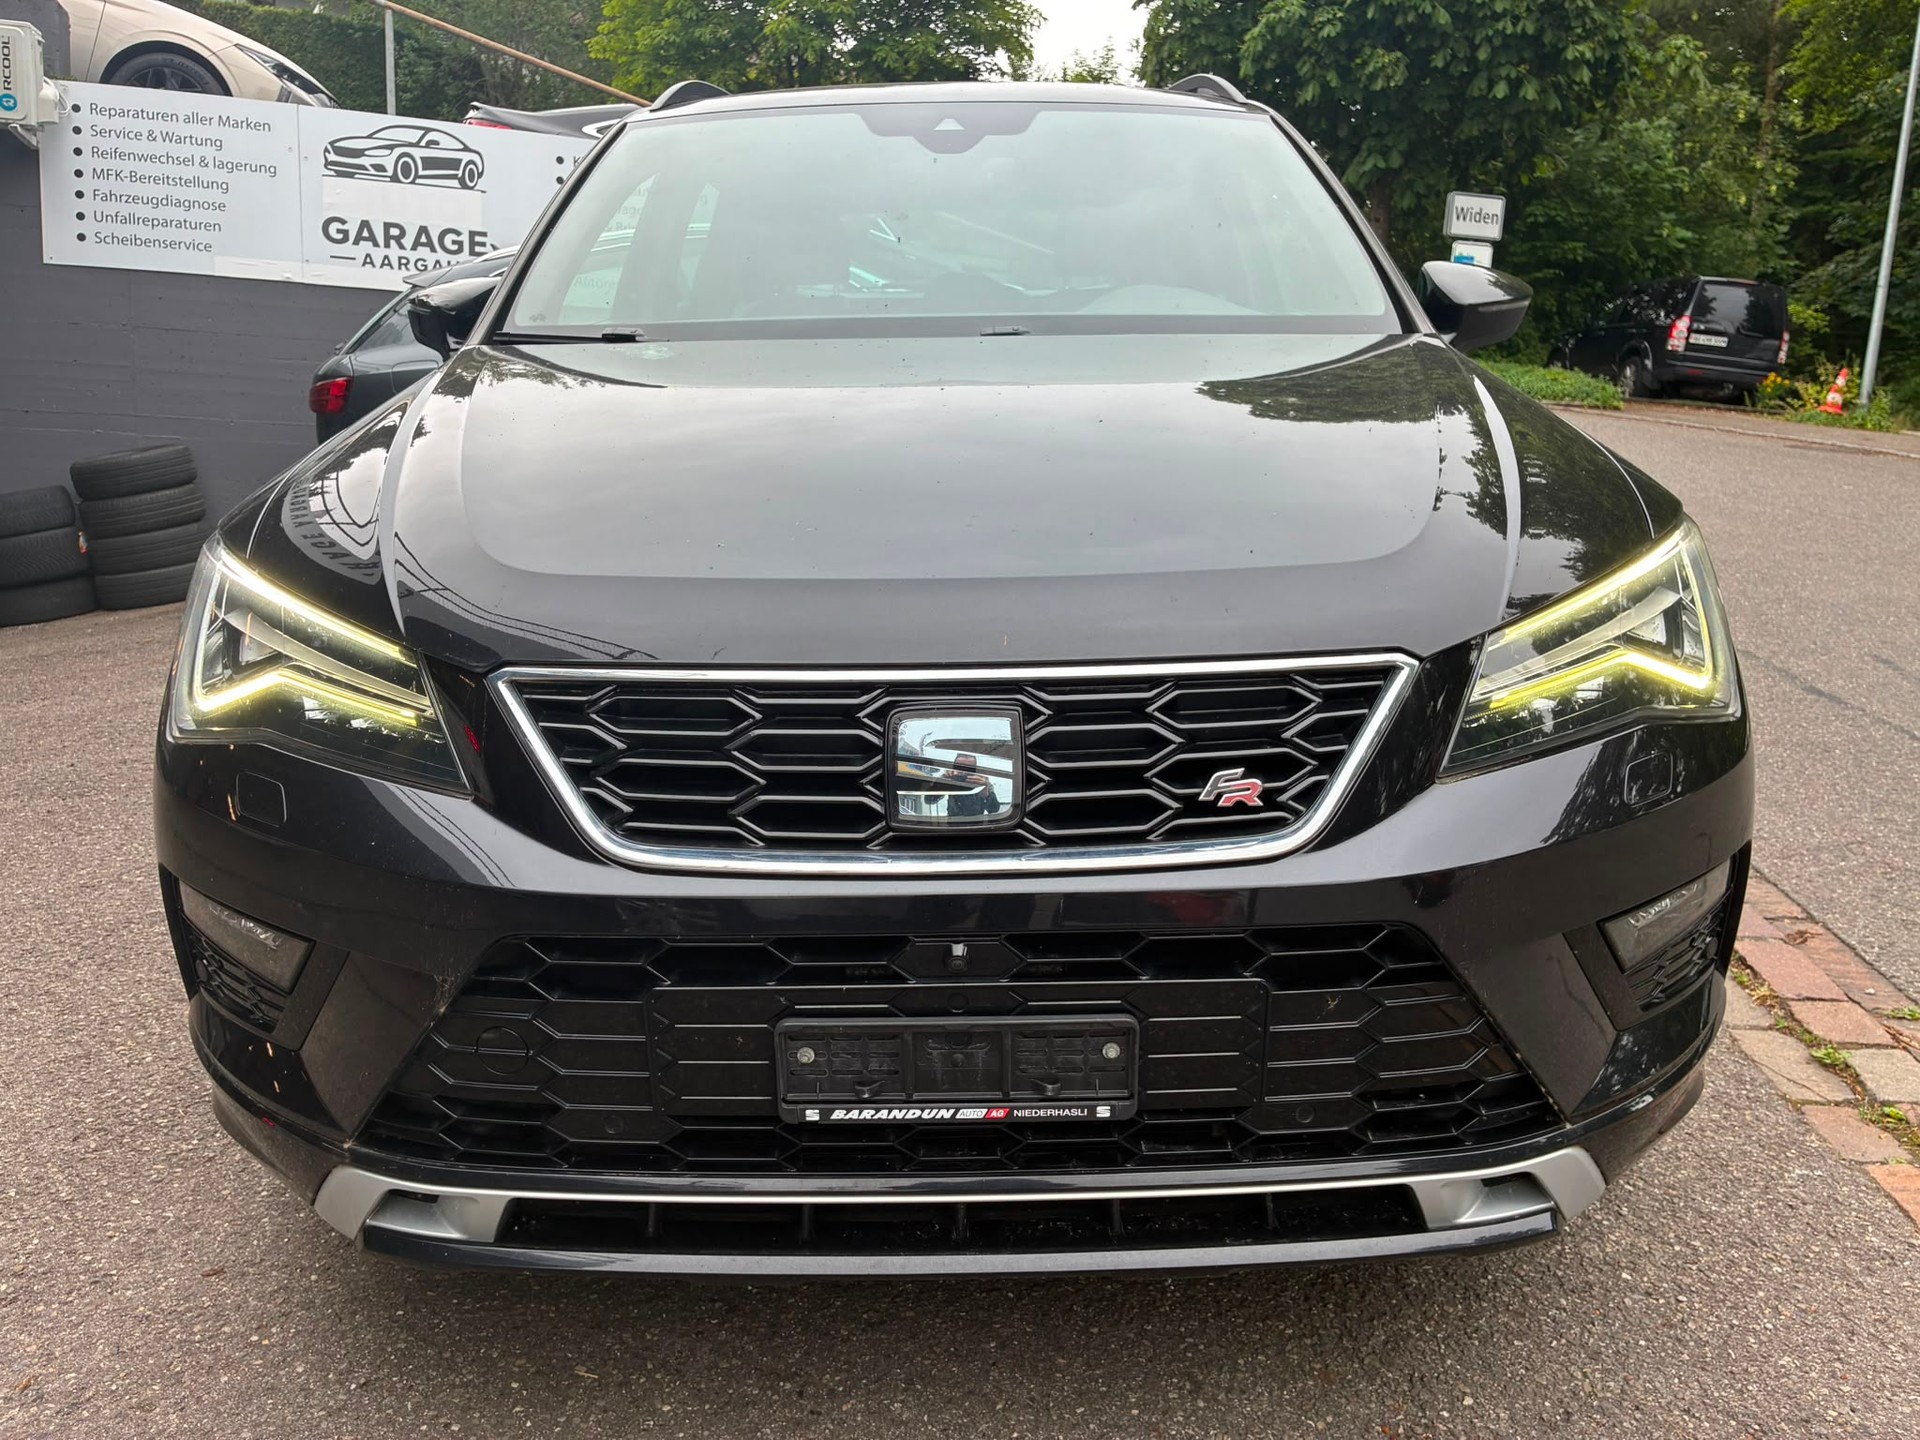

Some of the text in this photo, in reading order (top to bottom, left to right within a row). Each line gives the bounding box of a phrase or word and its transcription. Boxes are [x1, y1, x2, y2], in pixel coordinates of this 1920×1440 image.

[89, 102, 272, 132] Reparaturen aller Marken
[90, 124, 223, 151] Service & Wartung
[91, 146, 277, 177] Reifenwechsel & lagerung
[92, 167, 229, 194] MFK-Bereitstellung
[92, 189, 227, 212] Fahrzeugdiagnose
[93, 210, 222, 233] Unfallreparaturen
[1455, 206, 1499, 225] Widen
[94, 231, 213, 252] Scheibenservice
[321, 216, 489, 257] GARAGE
[1198, 768, 1264, 807] FR
[830, 1109, 956, 1120] BARANDUN
[960, 1109, 984, 1118] AUTO
[991, 1109, 1005, 1117] AG
[1013, 1108, 1088, 1118] NIEDERHASLI
